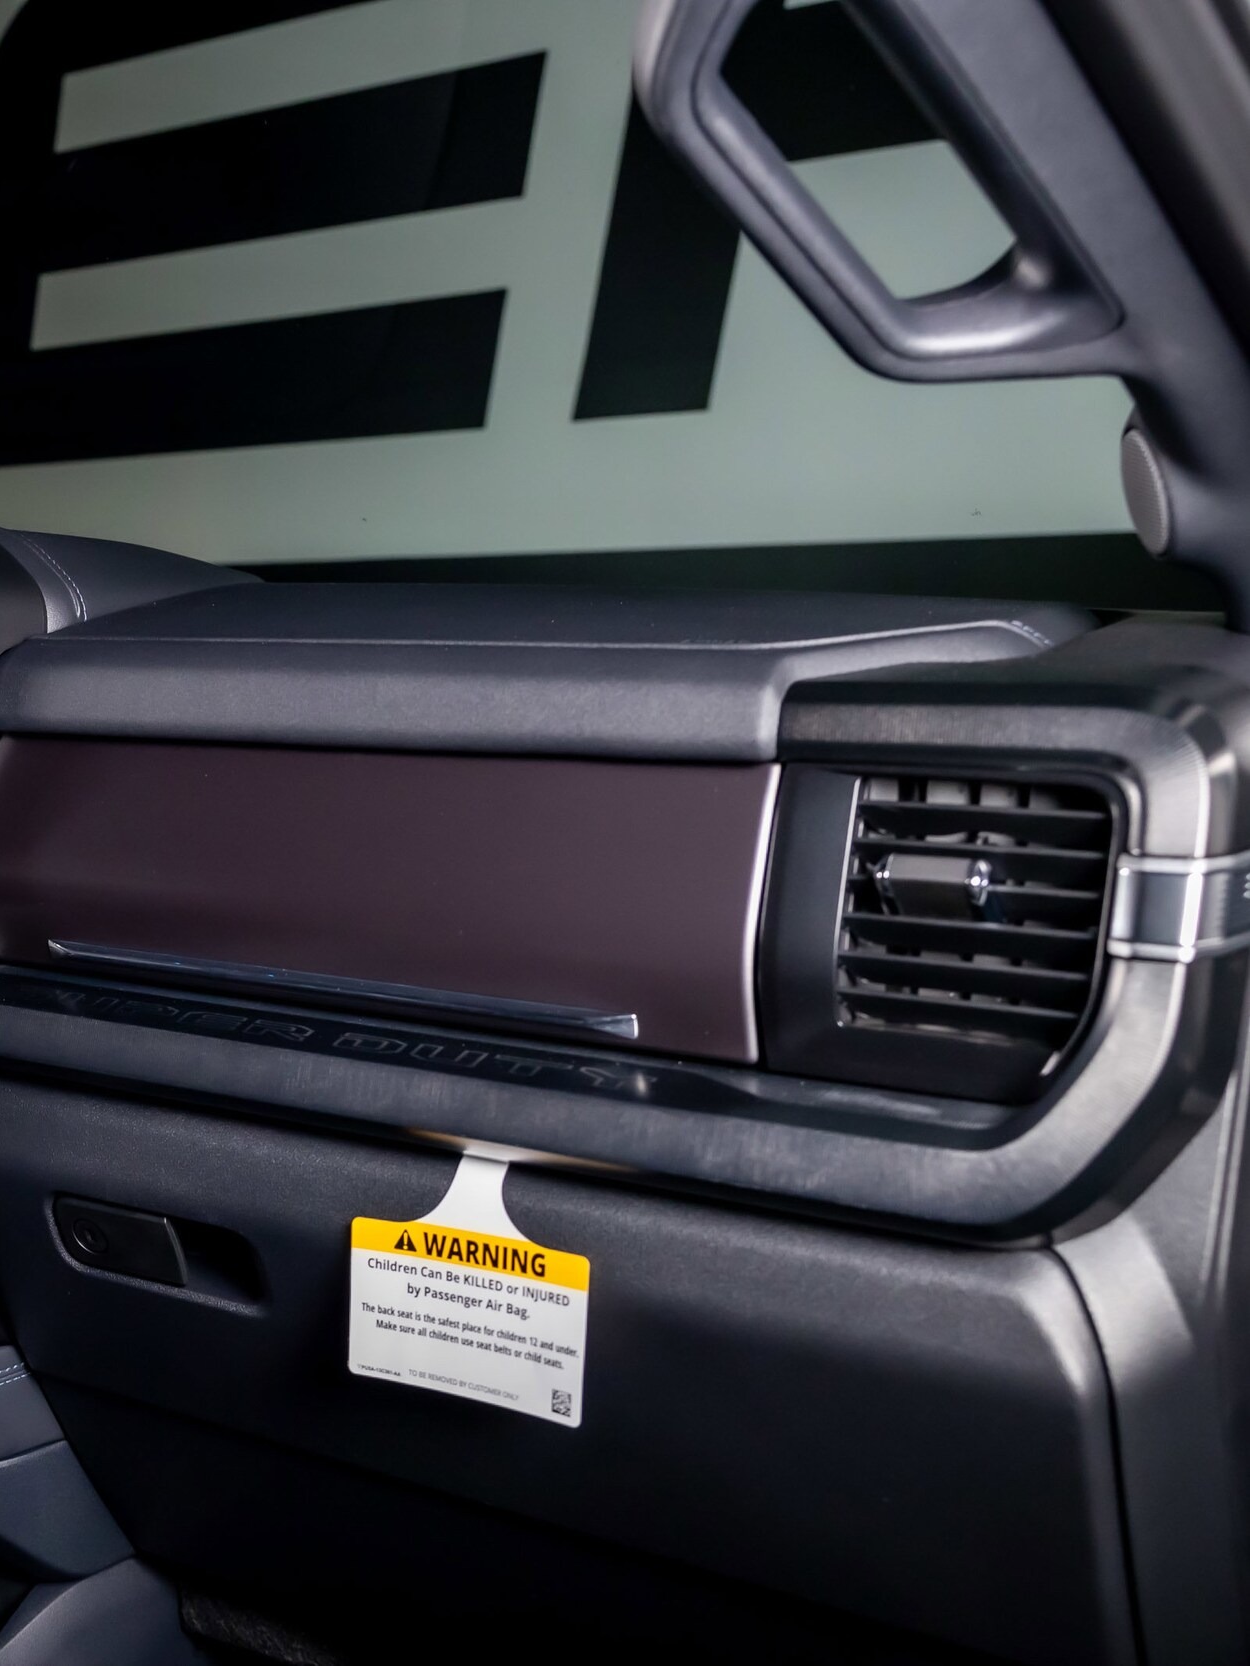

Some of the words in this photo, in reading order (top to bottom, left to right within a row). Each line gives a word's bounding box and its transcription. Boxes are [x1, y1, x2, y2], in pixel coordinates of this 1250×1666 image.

[423, 1232, 546, 1278] WARNING
[368, 1258, 417, 1276] Children
[420, 1266, 442, 1280] Can
[446, 1271, 460, 1284] Be
[464, 1274, 502, 1292] KILLED
[507, 1285, 518, 1294] or
[522, 1286, 570, 1307] INJURED
[407, 1282, 420, 1298] by
[424, 1286, 482, 1308] Passenger
[486, 1297, 502, 1310] Air
[362, 1302, 375, 1313] The
[378, 1304, 395, 1316] back
[398, 1310, 412, 1320] seat
[415, 1312, 421, 1321] is
[424, 1313, 436, 1324] the
[438, 1316, 460, 1330] safest
[462, 1321, 481, 1336] place
[484, 1324, 495, 1337] for
[496, 1327, 526, 1344] children
[530, 1336, 538, 1347] 12
[540, 1338, 553, 1351] and
[556, 1342, 579, 1358] under.
[376, 1319, 396, 1332] Make
[399, 1325, 415, 1335] sure
[418, 1326, 426, 1337] all
[429, 1328, 458, 1344] children
[461, 1337, 474, 1347] use
[476, 1339, 492, 1352] seat
[494, 1340, 512, 1356] belts
[514, 1349, 522, 1358] or
[524, 1348, 542, 1364] child
[544, 1354, 564, 1370] seats.
[419, 1371, 426, 1379] BE
[428, 1373, 457, 1386] REMOVED
[459, 1379, 466, 1388] BY
[468, 1381, 501, 1396] CUSTOMER
[503, 1390, 519, 1400] ONLY
